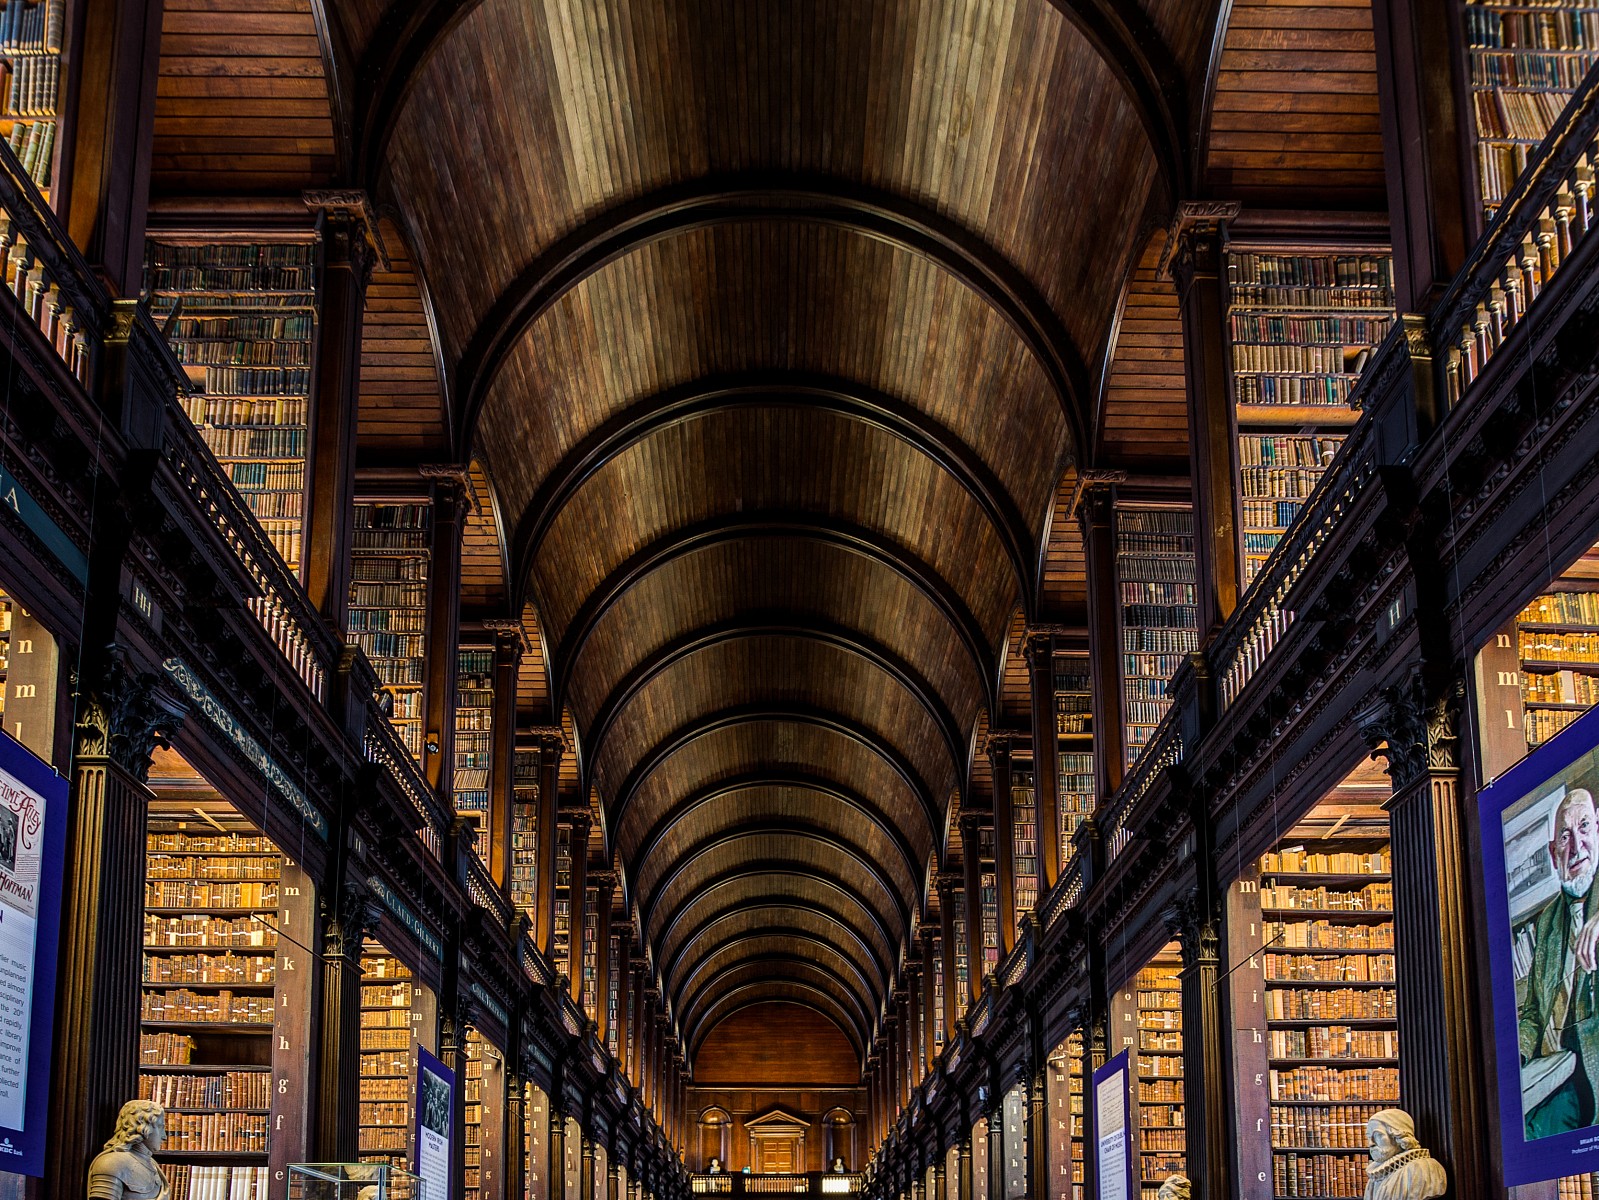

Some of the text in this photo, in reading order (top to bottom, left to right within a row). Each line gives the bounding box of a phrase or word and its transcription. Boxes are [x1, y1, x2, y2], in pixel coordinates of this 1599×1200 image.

[18, 640, 33, 653] n
[1497, 634, 1511, 647] n
[1497, 672, 1519, 685] m
[15, 685, 35, 698] m
[1505, 710, 1515, 728] l
[15, 722, 22, 742] l
[285, 887, 300, 895] m
[1239, 881, 1257, 893] m
[284, 910, 289, 925] l
[1251, 923, 1255, 936] l
[11, 959, 27, 972] music
[283, 957, 294, 970] k
[1249, 955, 1259, 968] k
[7, 982, 25, 995] almost
[282, 994, 287, 1006] i
[1253, 990, 1257, 1002] i
[5, 1029, 22, 1042] library
[1252, 1028, 1262, 1043] h
[279, 1036, 289, 1049] h
[1, 1065, 20, 1077] further
[278, 1079, 289, 1093] g
[276, 1115, 284, 1130] f
[1257, 1118, 1263, 1131] f
